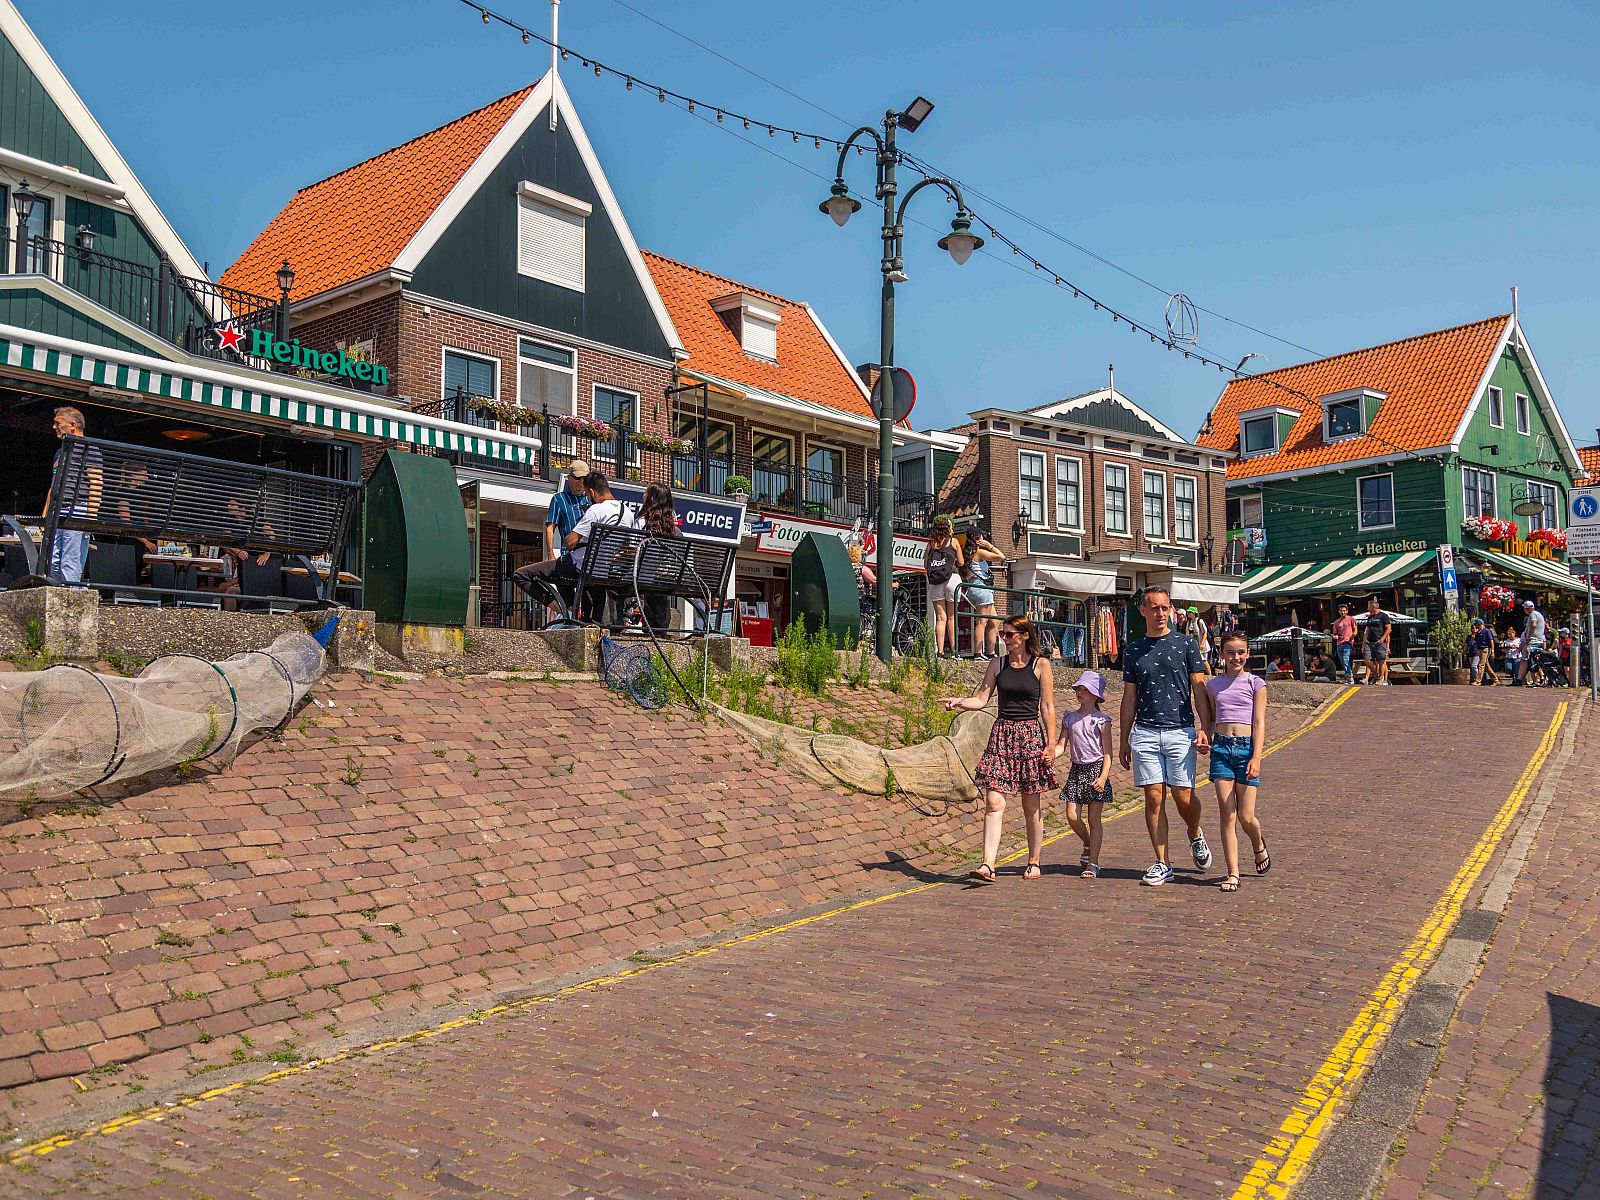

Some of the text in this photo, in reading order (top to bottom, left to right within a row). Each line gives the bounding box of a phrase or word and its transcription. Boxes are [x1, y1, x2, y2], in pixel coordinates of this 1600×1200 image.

[250, 328, 388, 385] Heineken
[686, 510, 733, 530] OFFICE
[1365, 539, 1428, 555] Heineken
